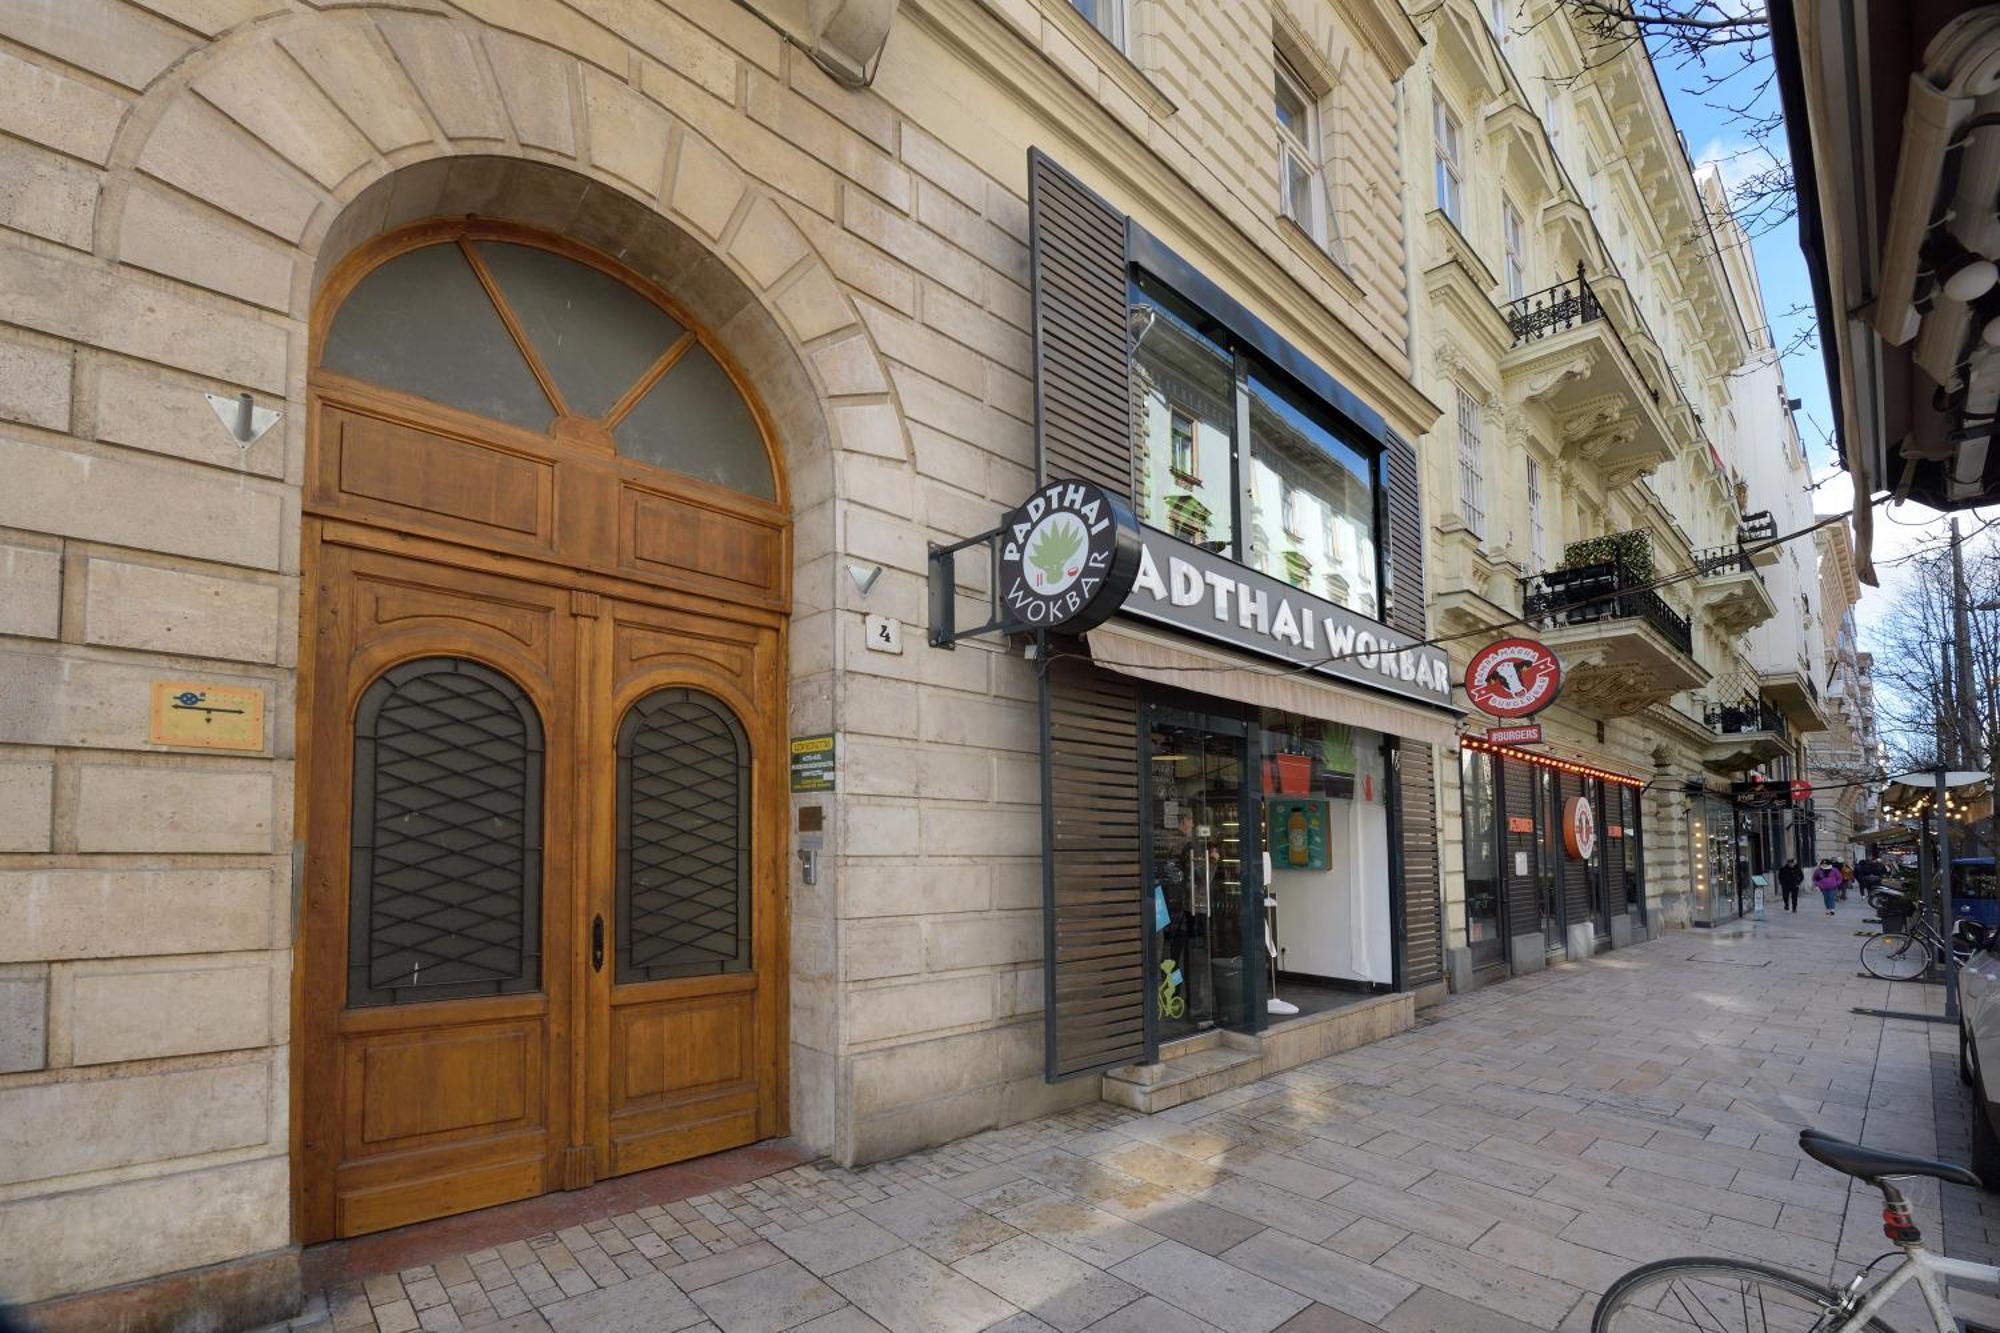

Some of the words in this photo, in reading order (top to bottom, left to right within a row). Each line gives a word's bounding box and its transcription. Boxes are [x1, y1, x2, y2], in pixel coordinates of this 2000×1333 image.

[1004, 484, 1110, 561] PADTHAI
[1007, 550, 1109, 622] WOKBAR
[1132, 543, 1314, 649] ADTHAI
[1323, 617, 1450, 695] WOKBAR
[879, 624, 891, 643] 4
